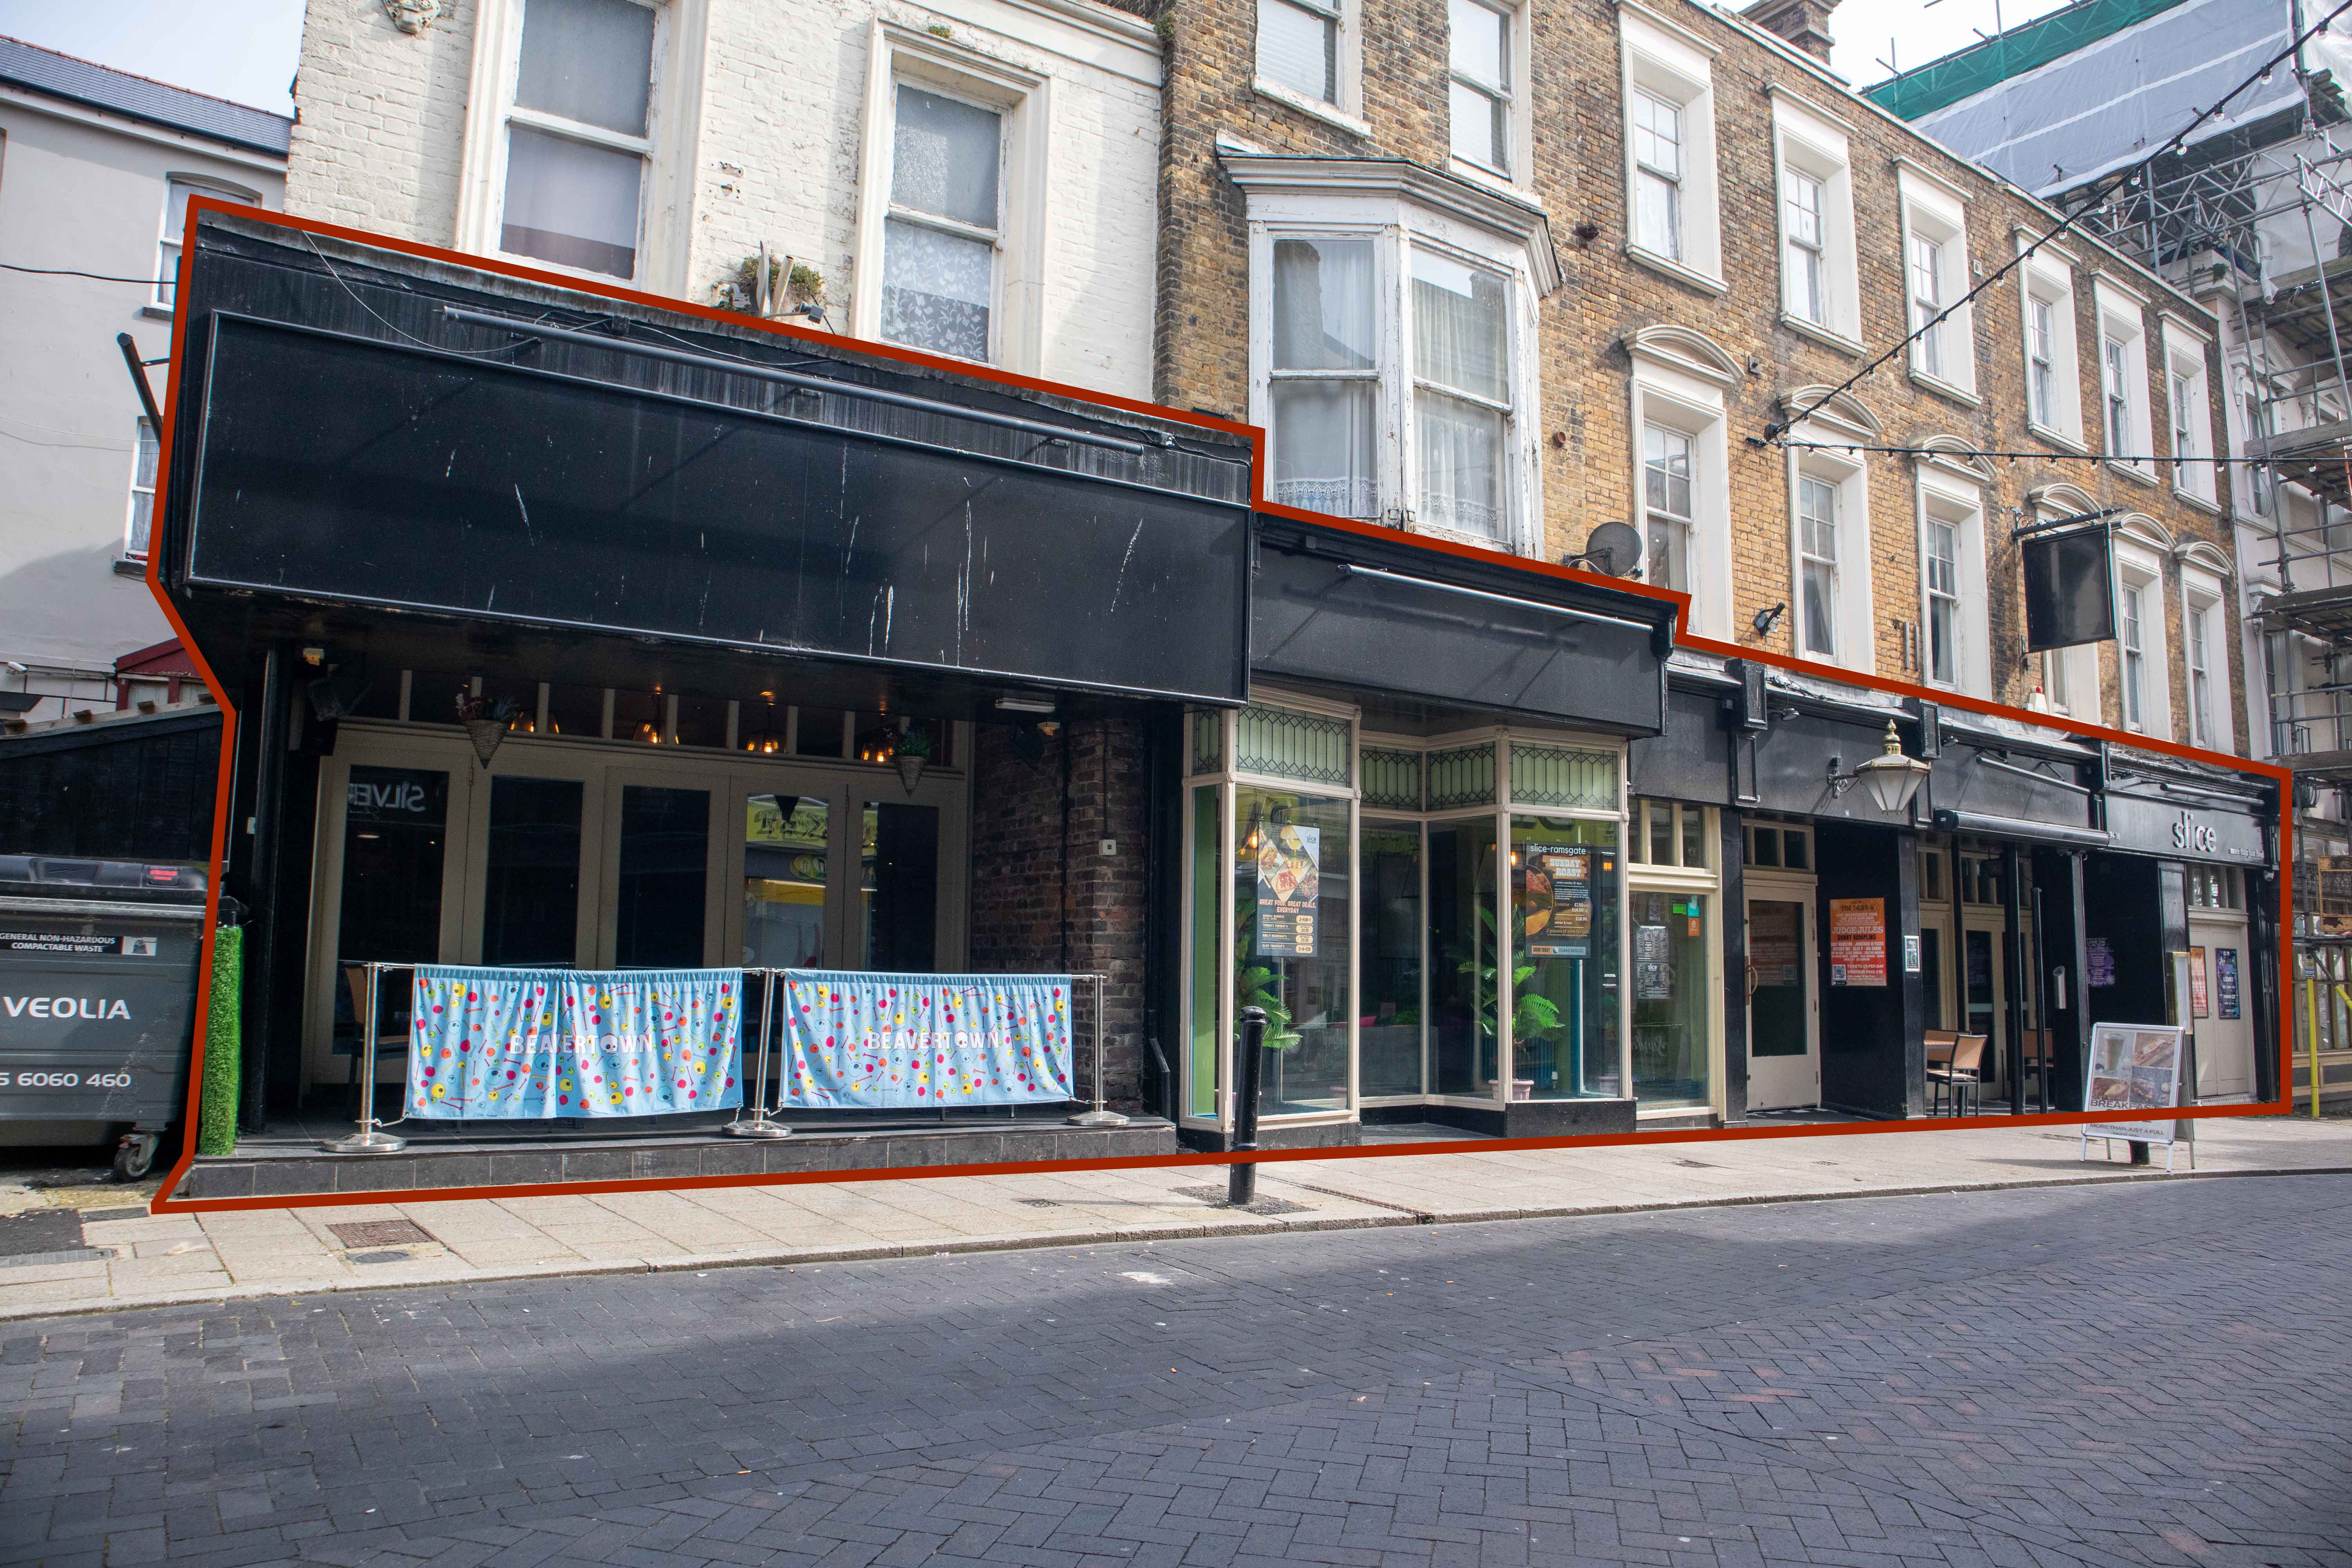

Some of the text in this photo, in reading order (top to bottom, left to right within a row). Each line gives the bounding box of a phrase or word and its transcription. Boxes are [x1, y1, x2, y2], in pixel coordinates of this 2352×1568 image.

[2173, 809, 2217, 852] slice
[1530, 843, 1586, 856] slice-ramsgate
[1550, 858, 1580, 867] SUNDAY
[1556, 868, 1581, 877] ROAST
[11, 942, 73, 951] COMPACTABLE
[39, 935, 116, 944] NON-HAZARDOUS
[2, 996, 131, 1020] VEOLIA
[510, 1033, 654, 1055] BEAVERTOWN
[868, 1031, 1000, 1050] BEAVERTOWN
[17, 1072, 79, 1087] 6060
[85, 1073, 131, 1087] 460
